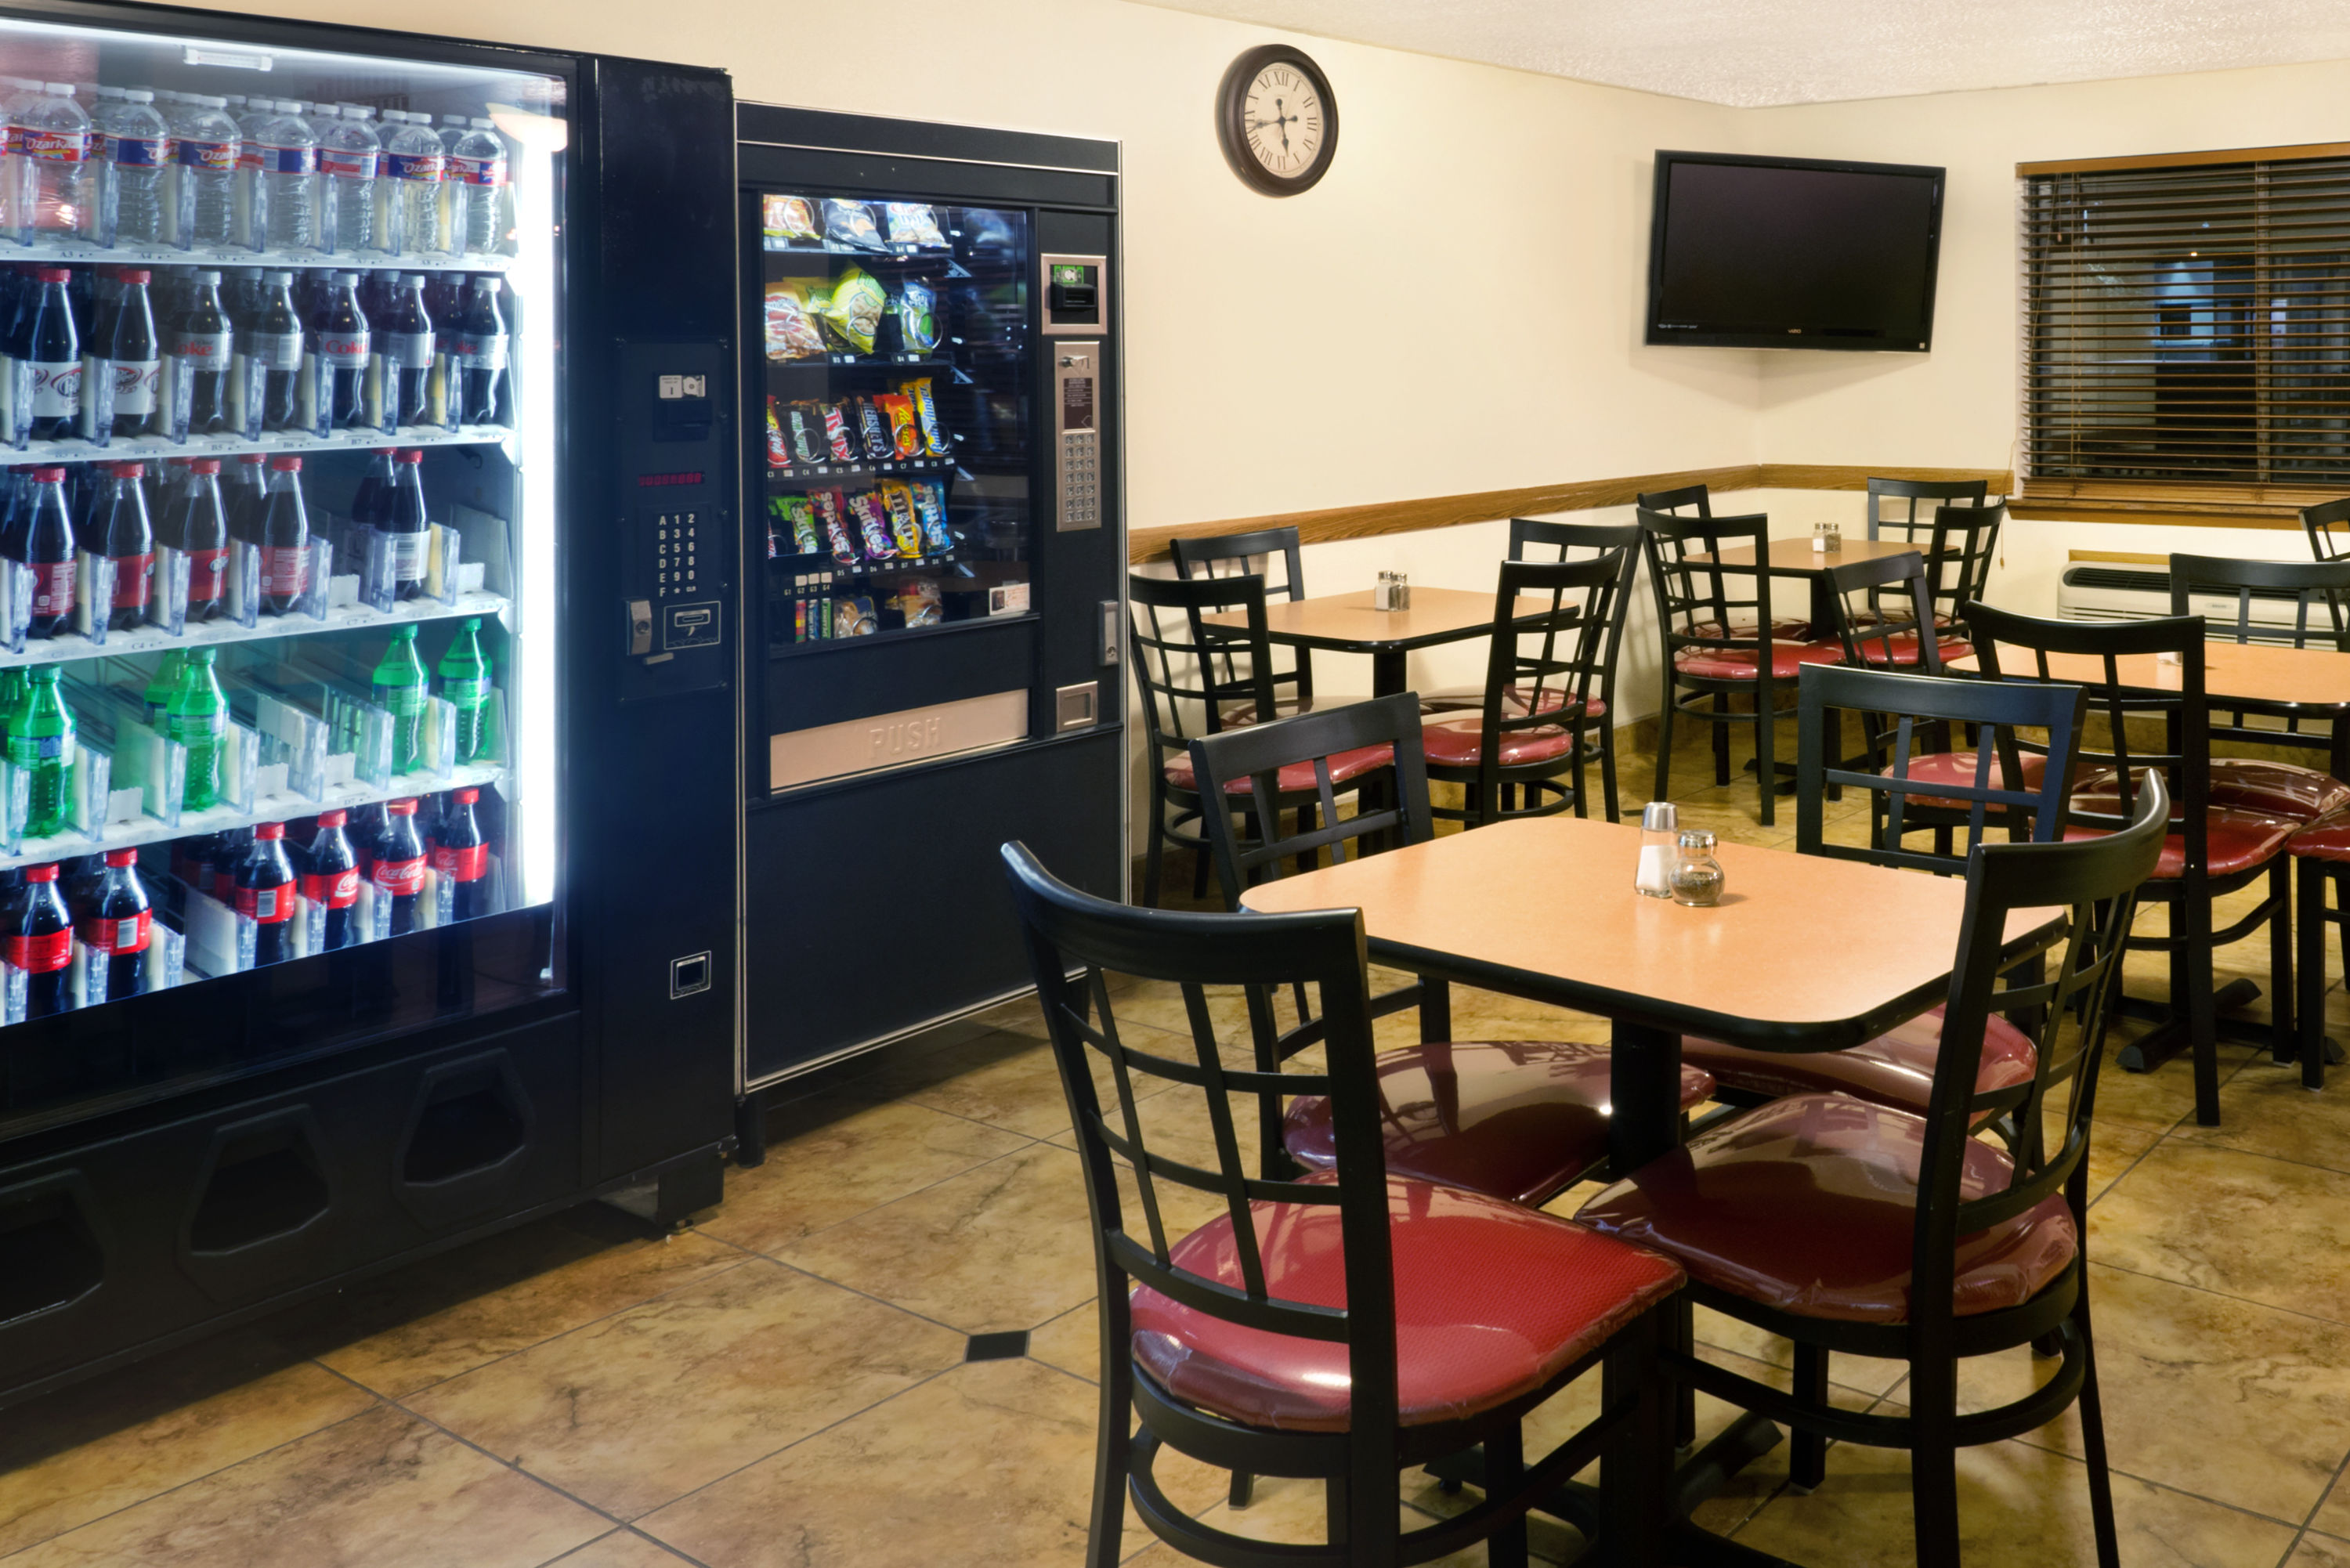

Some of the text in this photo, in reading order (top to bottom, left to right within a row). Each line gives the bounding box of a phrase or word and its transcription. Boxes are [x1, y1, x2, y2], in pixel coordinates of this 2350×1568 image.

[1274, 71, 1289, 86] XII
[1293, 80, 1300, 92] I
[1303, 96, 1314, 108] II
[1307, 117, 1317, 131] III
[178, 341, 213, 356] oke
[659, 514, 695, 526] A 1 2
[820, 492, 851, 552] Skittles
[922, 485, 945, 546] Skittles
[848, 496, 884, 554] Skittles
[659, 528, 695, 540] B 3 4
[659, 542, 695, 554] C 5 6
[659, 556, 695, 569] D 7 8
[660, 570, 695, 583] E 9 0
[660, 587, 666, 597] F
[870, 717, 941, 758] PUSH
